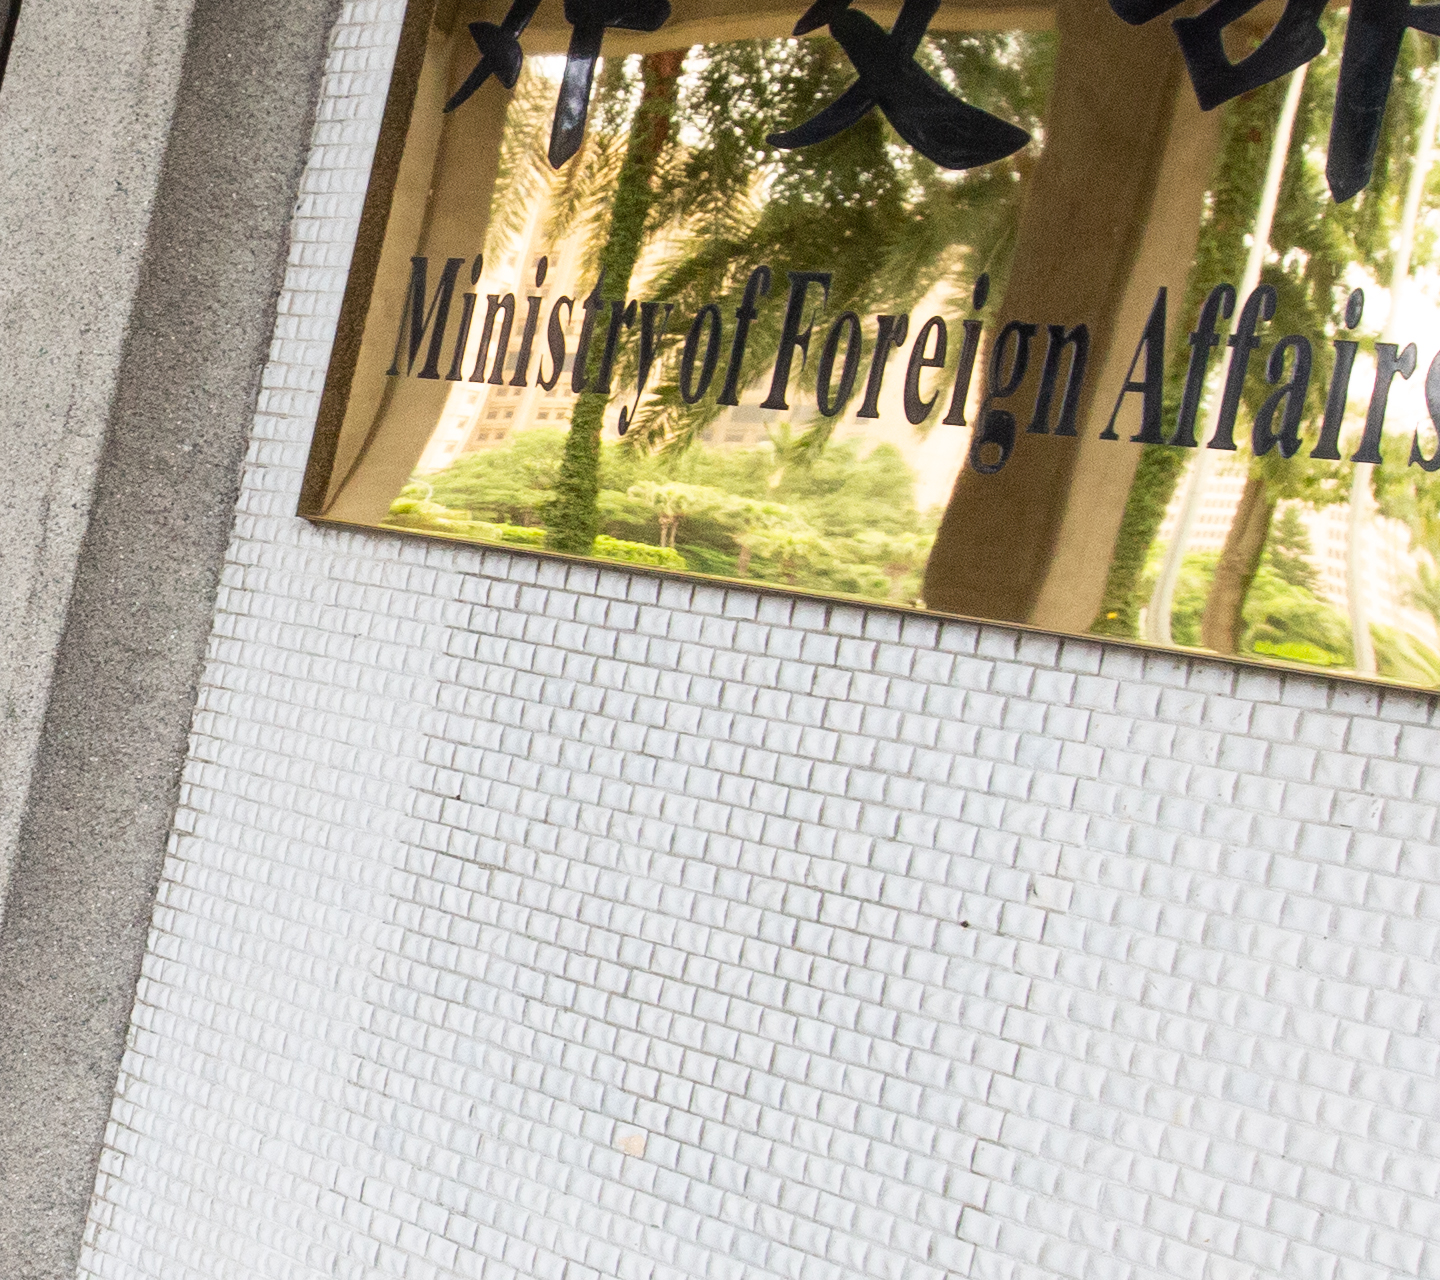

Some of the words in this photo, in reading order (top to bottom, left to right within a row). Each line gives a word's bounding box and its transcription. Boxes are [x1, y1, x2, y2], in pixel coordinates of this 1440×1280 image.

[386, 255, 672, 435] Ministry
[680, 265, 771, 406] of
[760, 272, 1091, 474] Foreign
